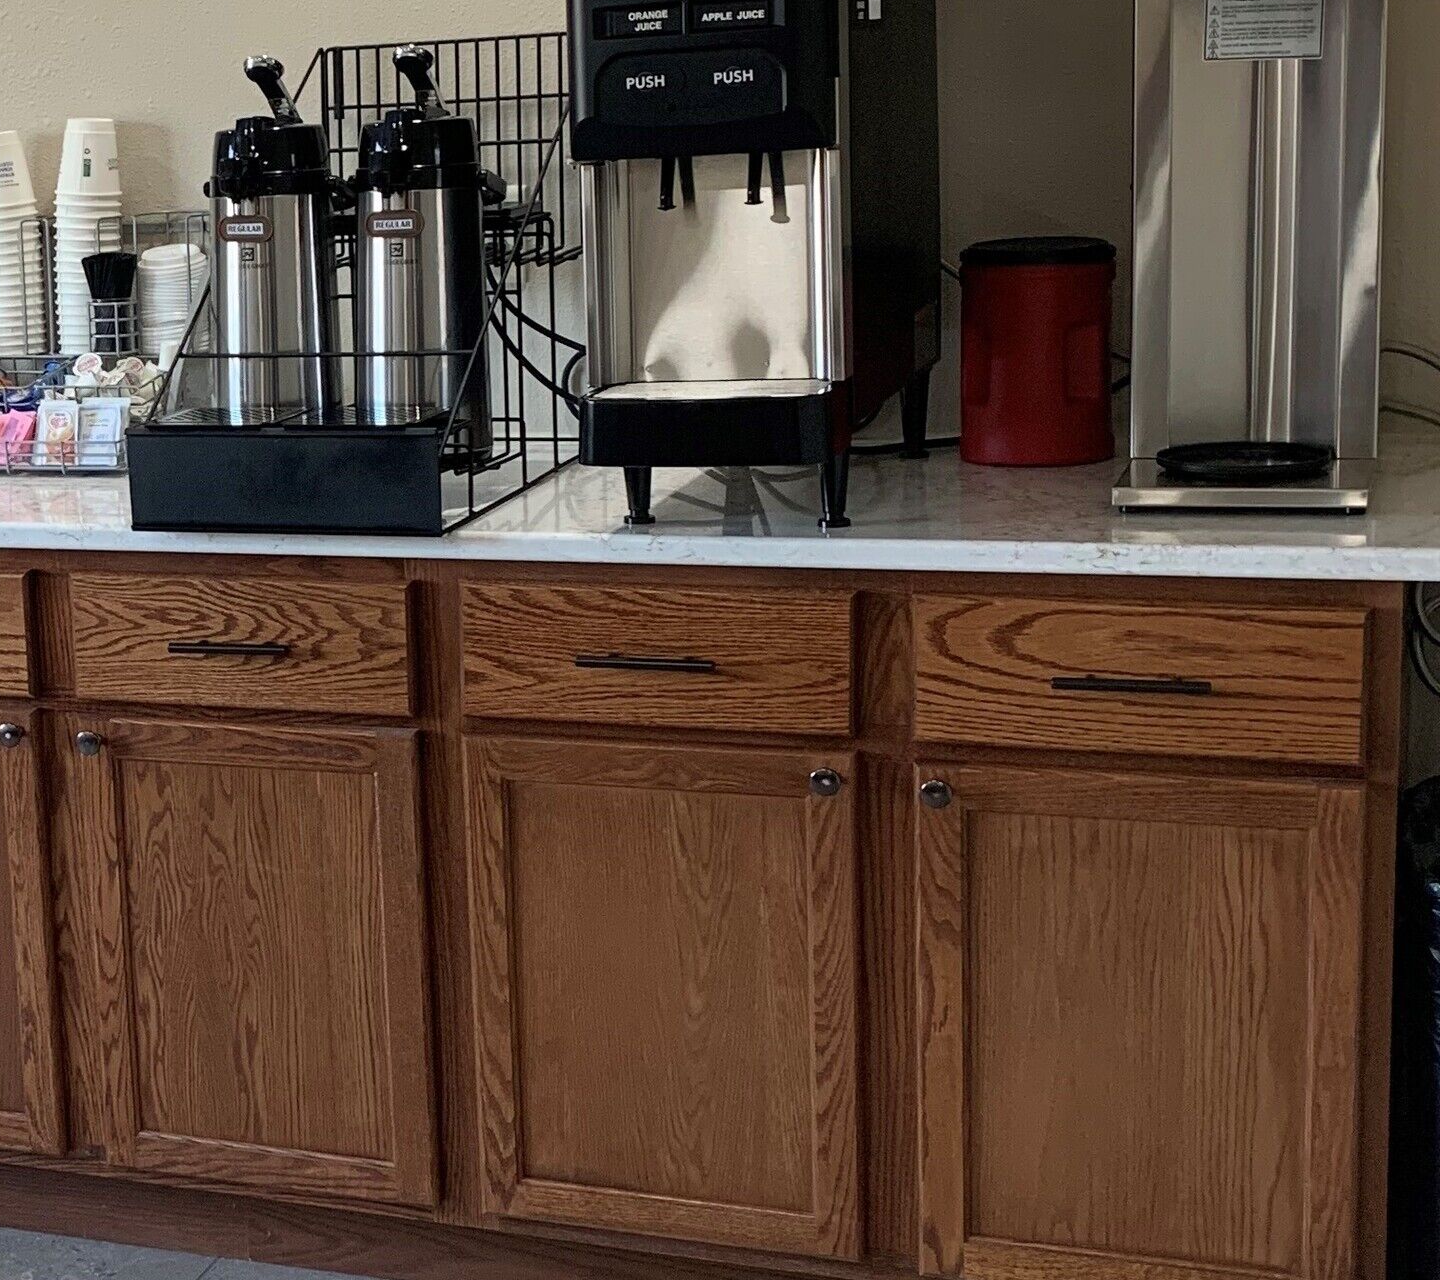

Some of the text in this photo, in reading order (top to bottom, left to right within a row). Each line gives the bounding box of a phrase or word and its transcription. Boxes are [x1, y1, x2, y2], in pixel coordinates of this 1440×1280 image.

[628, 9, 669, 22] ORANGE
[701, 9, 766, 23] APPLE JUICE
[634, 20, 663, 32] JUICE
[625, 74, 666, 90] PUSH
[713, 68, 754, 85] PUSH
[227, 224, 263, 233] REGULAR
[374, 219, 412, 229] REGULAR
